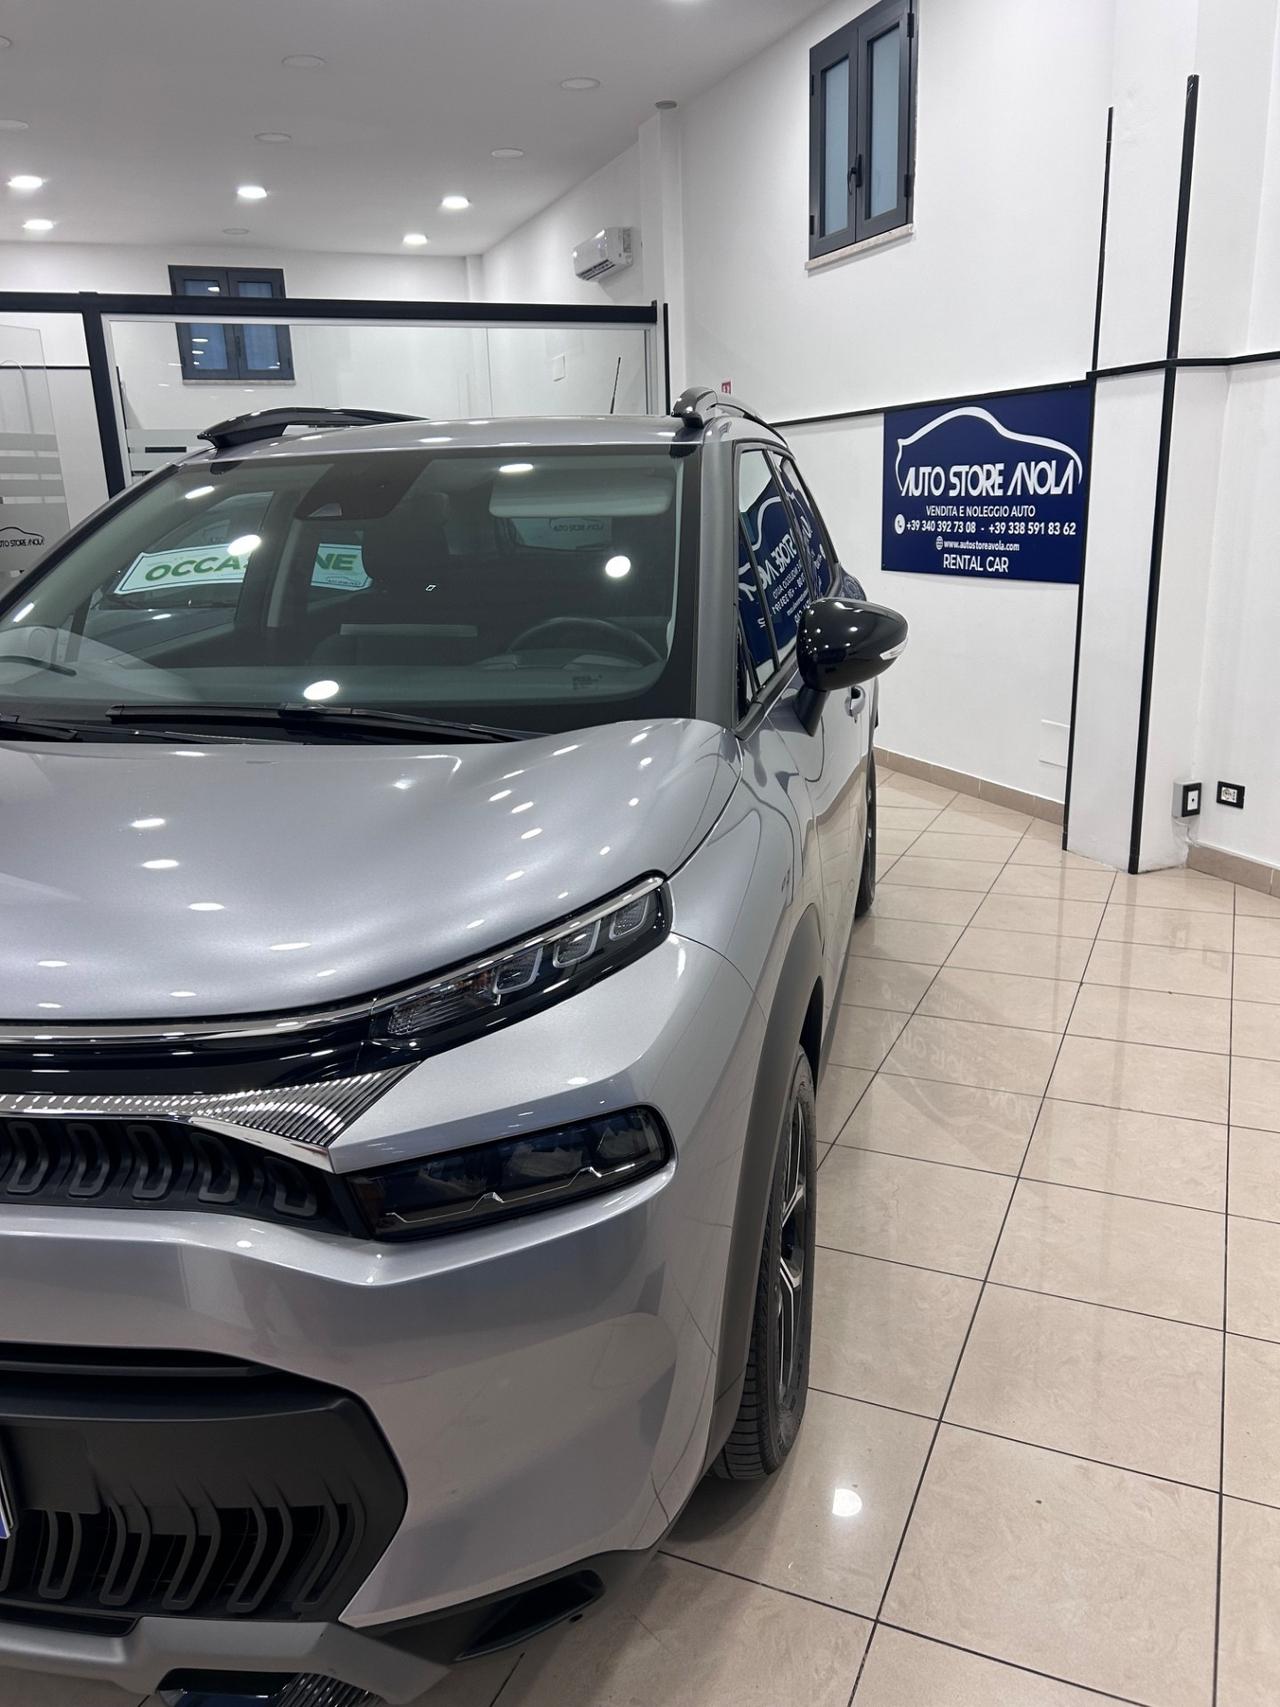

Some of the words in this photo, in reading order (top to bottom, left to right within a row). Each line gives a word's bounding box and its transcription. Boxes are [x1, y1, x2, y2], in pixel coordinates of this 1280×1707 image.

[901, 467, 945, 496] AUTO
[949, 463, 1004, 496] STORE
[926, 505, 958, 517] VENDITA
[959, 505, 965, 517] E
[966, 505, 1009, 517] NOLEGGIO
[1010, 505, 1036, 517] AUTO
[907, 520, 920, 531] +39
[921, 520, 936, 532] 340
[937, 521, 952, 532] 392
[953, 521, 964, 533] 73
[965, 521, 976, 533] 08
[989, 522, 1006, 534] +39
[1008, 522, 1026, 534] 338
[1027, 522, 1045, 535] 591
[1047, 522, 1061, 535] 83
[1062, 522, 1077, 536] 62
[943, 540, 1020, 551] www.autostoreavola.com
[943, 554, 984, 571] RENTAL
[986, 556, 1009, 573] CAR
